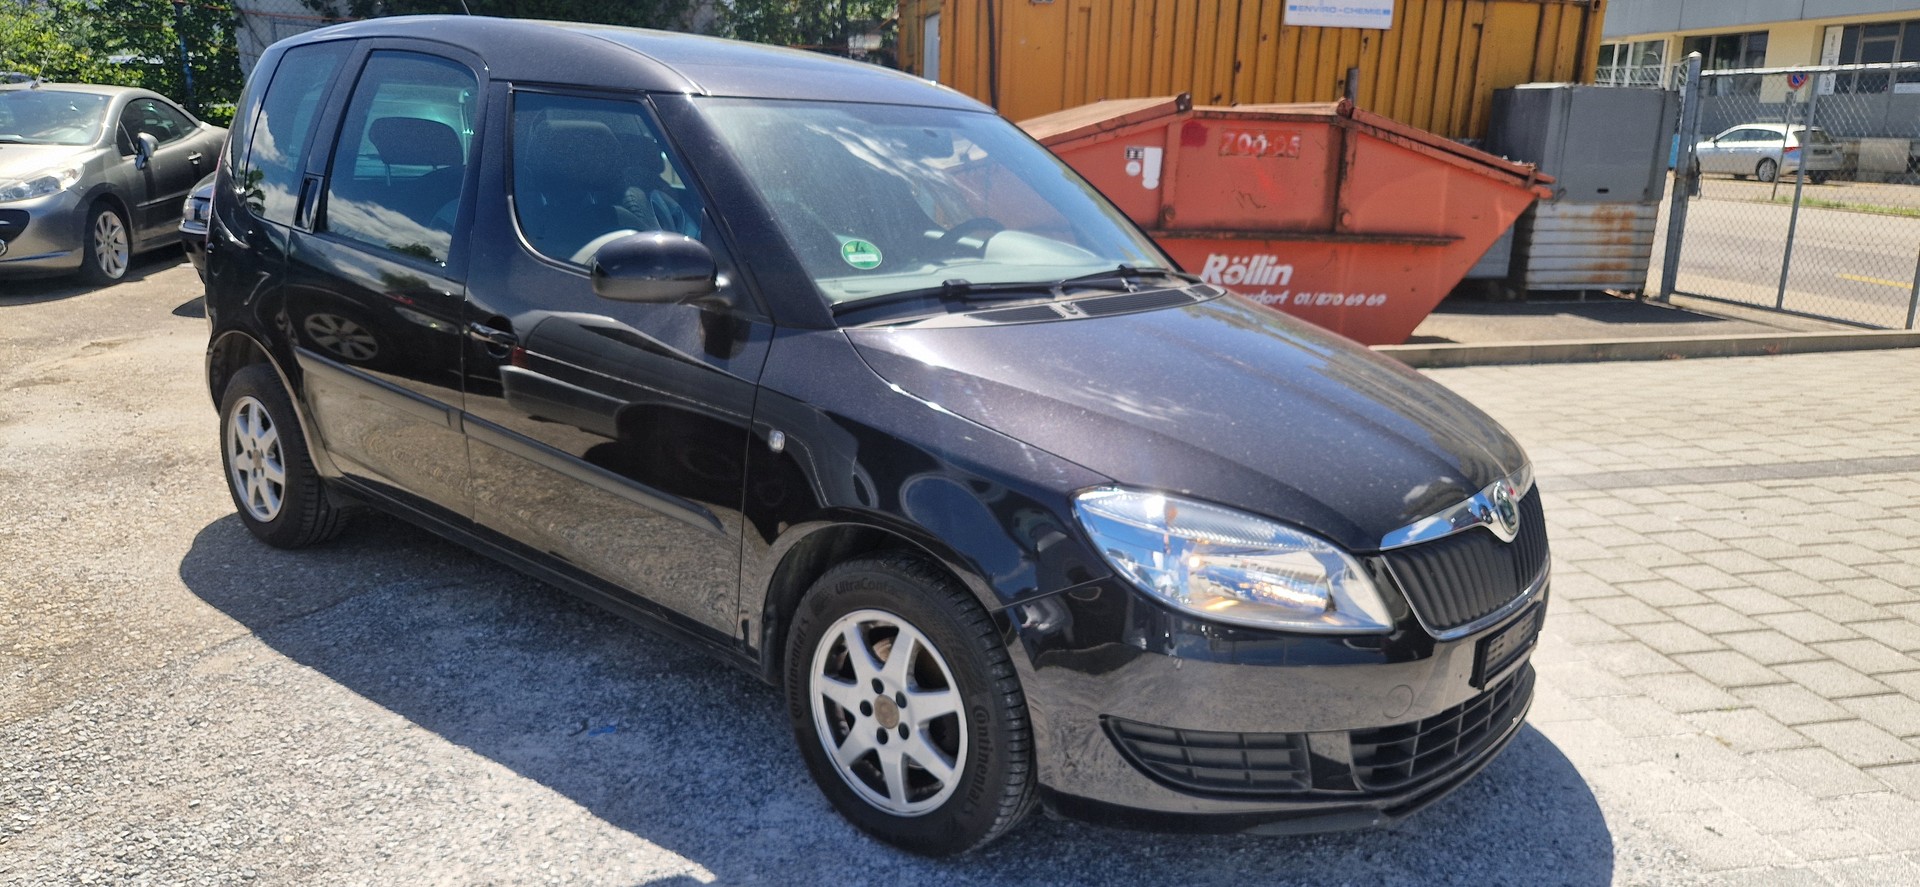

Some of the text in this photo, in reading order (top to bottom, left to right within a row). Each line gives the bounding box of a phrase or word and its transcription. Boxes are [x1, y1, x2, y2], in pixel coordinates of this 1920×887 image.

[1201, 253, 1293, 286] Röllin
[787, 627, 807, 719] Continental
[966, 705, 992, 806] Continental
